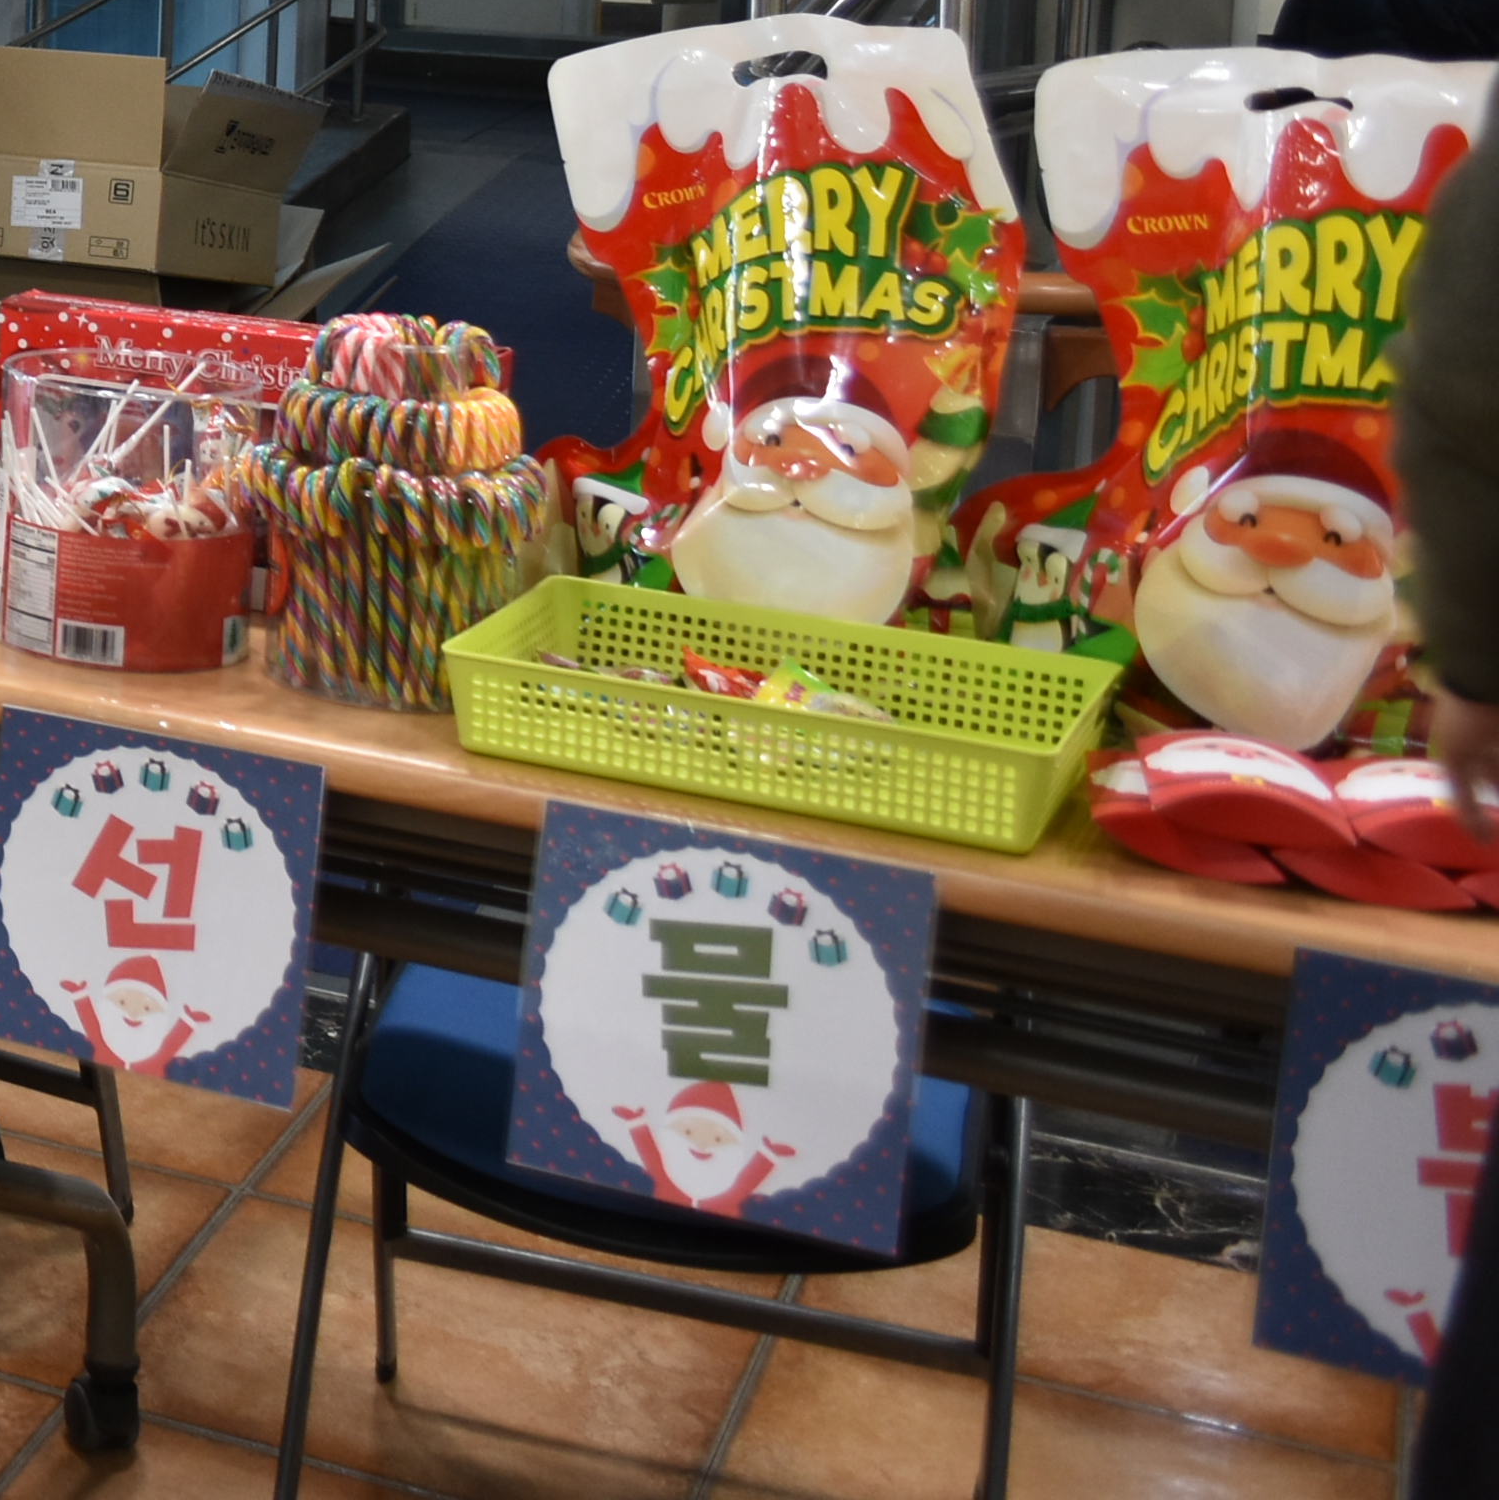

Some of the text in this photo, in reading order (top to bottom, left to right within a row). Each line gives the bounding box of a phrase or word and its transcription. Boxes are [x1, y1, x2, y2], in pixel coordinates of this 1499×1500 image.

[643, 183, 706, 209] CROWN
[691, 165, 905, 289] MERRY
[1126, 213, 1209, 235] CROWN
[1204, 214, 1424, 336] MERRY
[94, 335, 187, 383] Merry
[72, 813, 203, 952] 선
[642, 918, 789, 1087] 물
